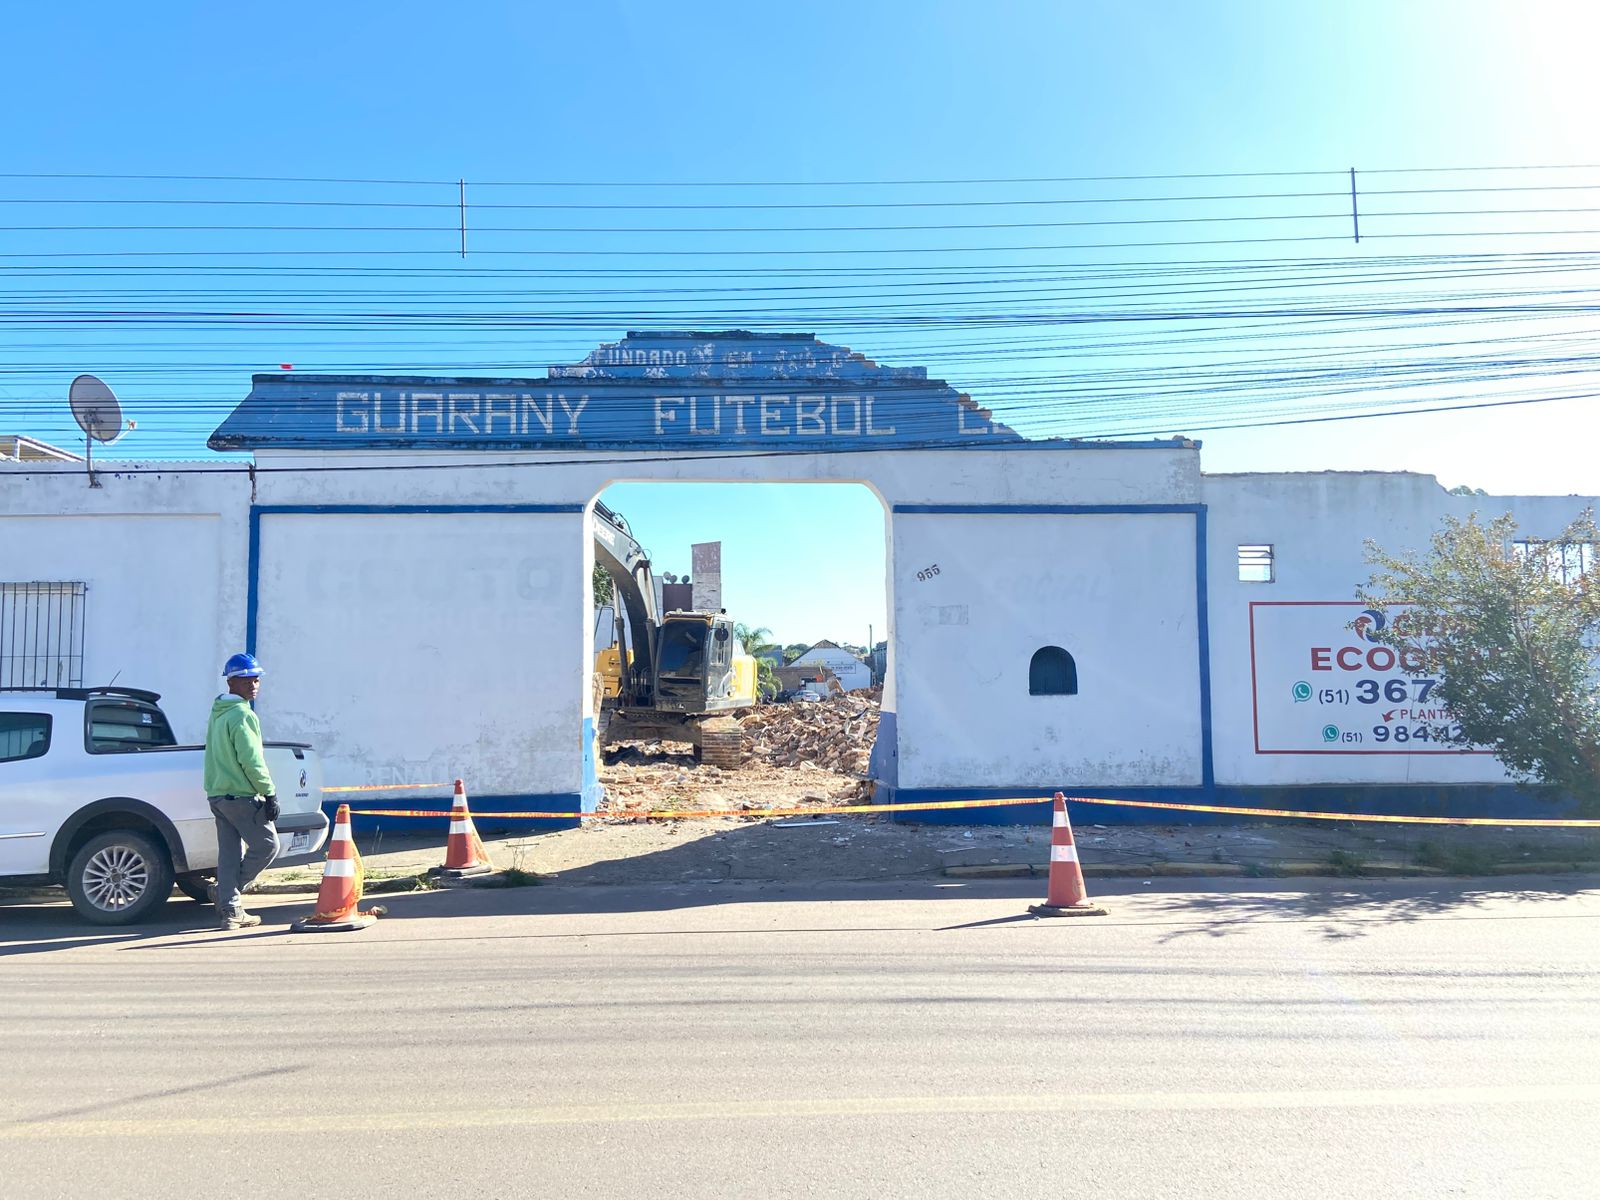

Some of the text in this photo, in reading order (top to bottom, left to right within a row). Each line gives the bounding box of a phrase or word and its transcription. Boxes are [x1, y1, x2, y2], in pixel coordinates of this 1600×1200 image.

[336, 392, 589, 434] GUARANY
[655, 395, 897, 435] FUTEBOL
[917, 563, 941, 581] 955
[1310, 646, 1441, 672] ECOG
[1318, 679, 1437, 705] (51) 367
[1400, 709, 1462, 720] PLANTA
[1341, 732, 1363, 743] (51)
